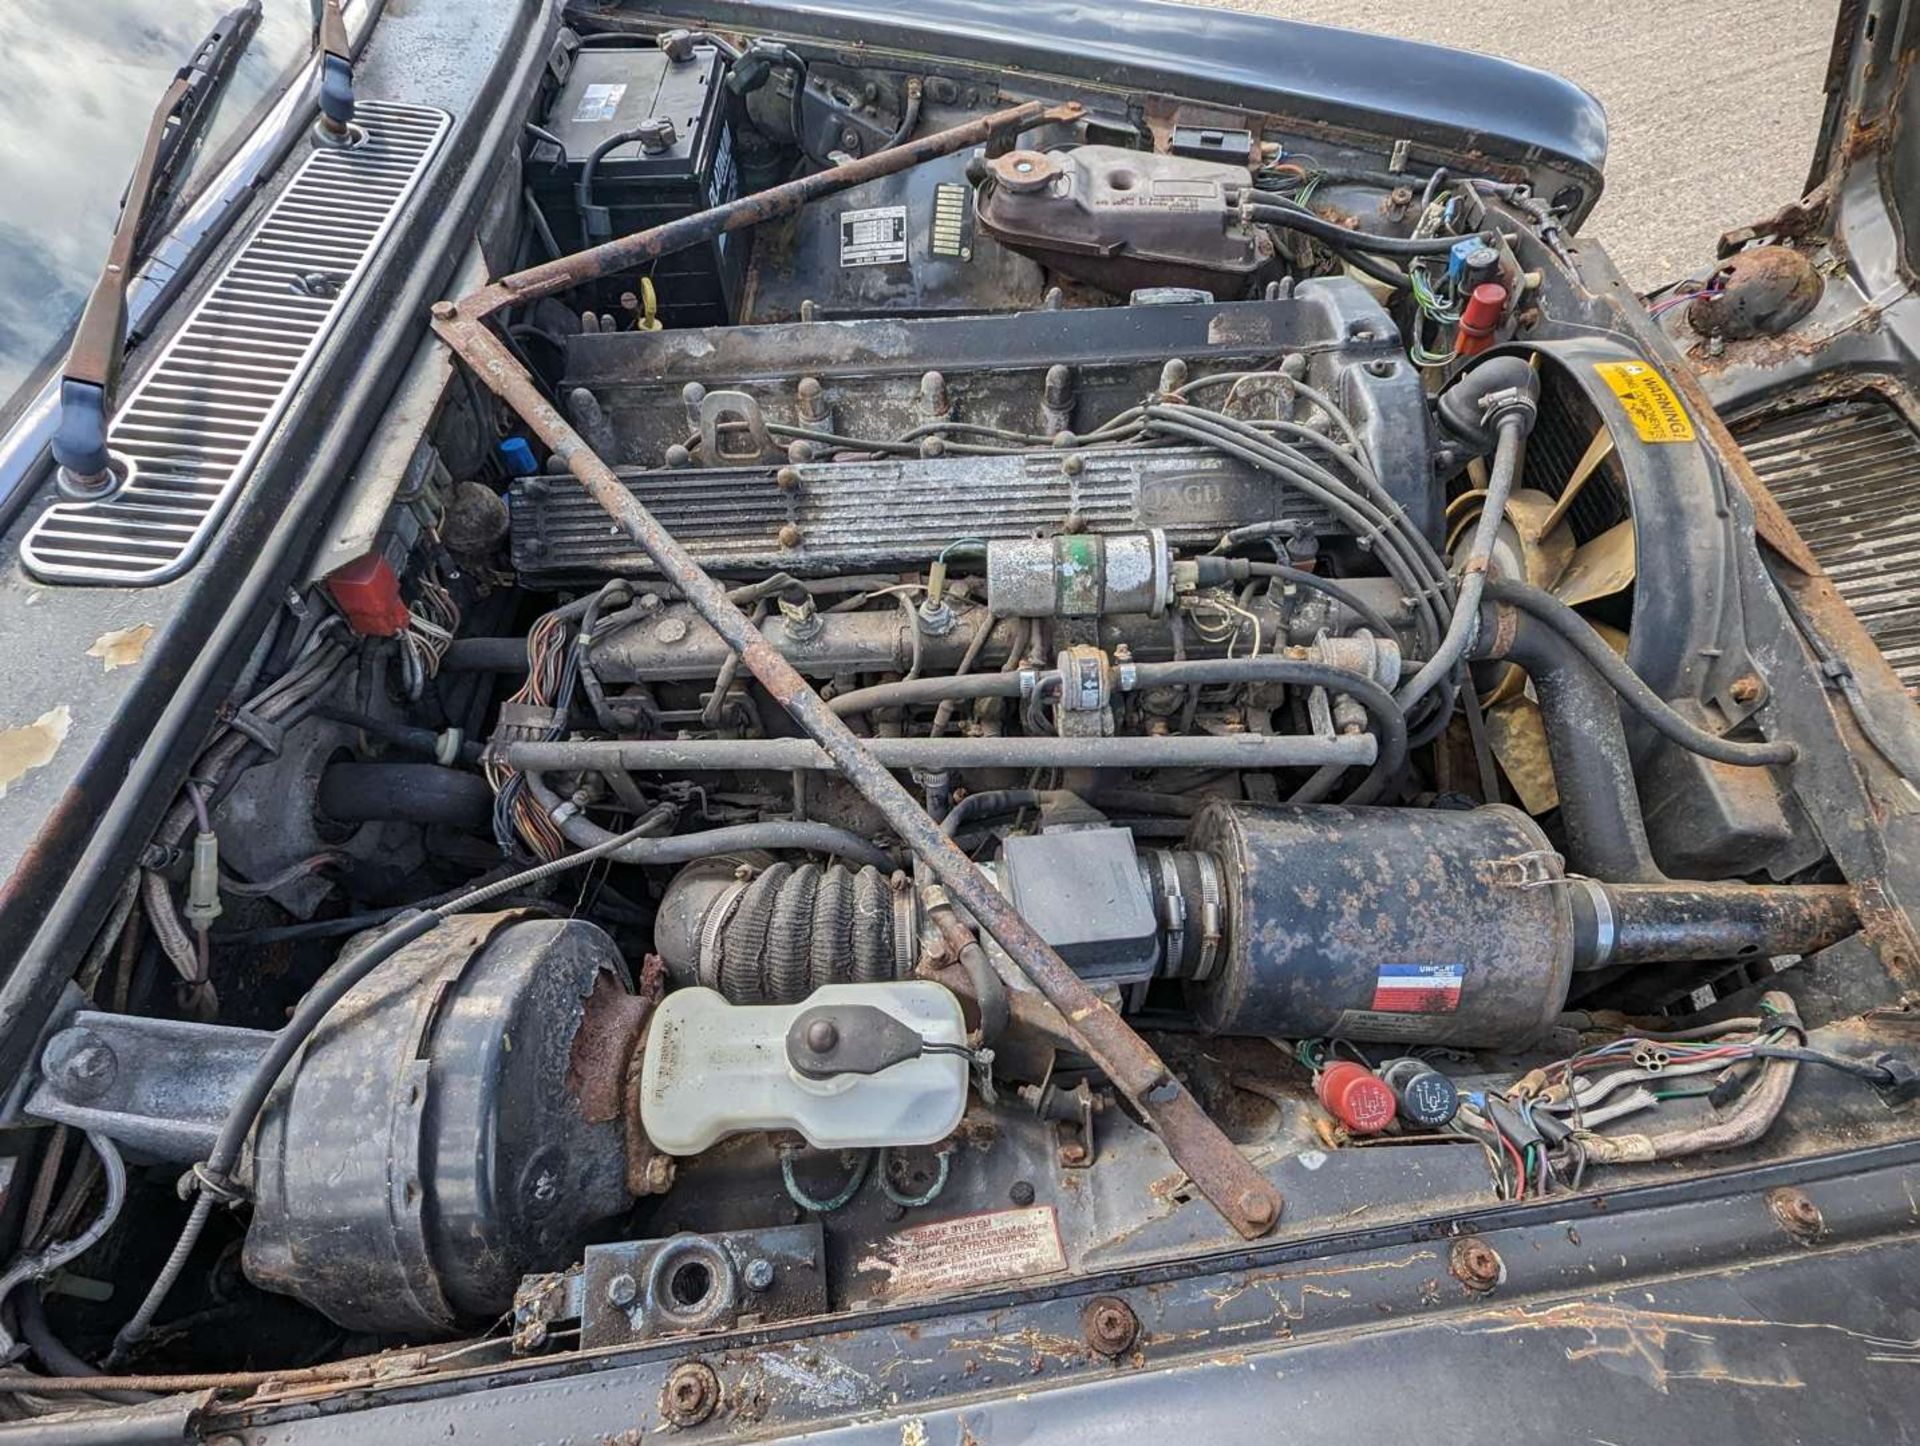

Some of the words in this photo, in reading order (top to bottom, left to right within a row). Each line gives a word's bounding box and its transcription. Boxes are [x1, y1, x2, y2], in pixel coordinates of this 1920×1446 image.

[1642, 377, 1690, 438] WARNING!
[913, 1226, 949, 1242] BRAKE
[950, 1219, 992, 1234] SYSTEM
